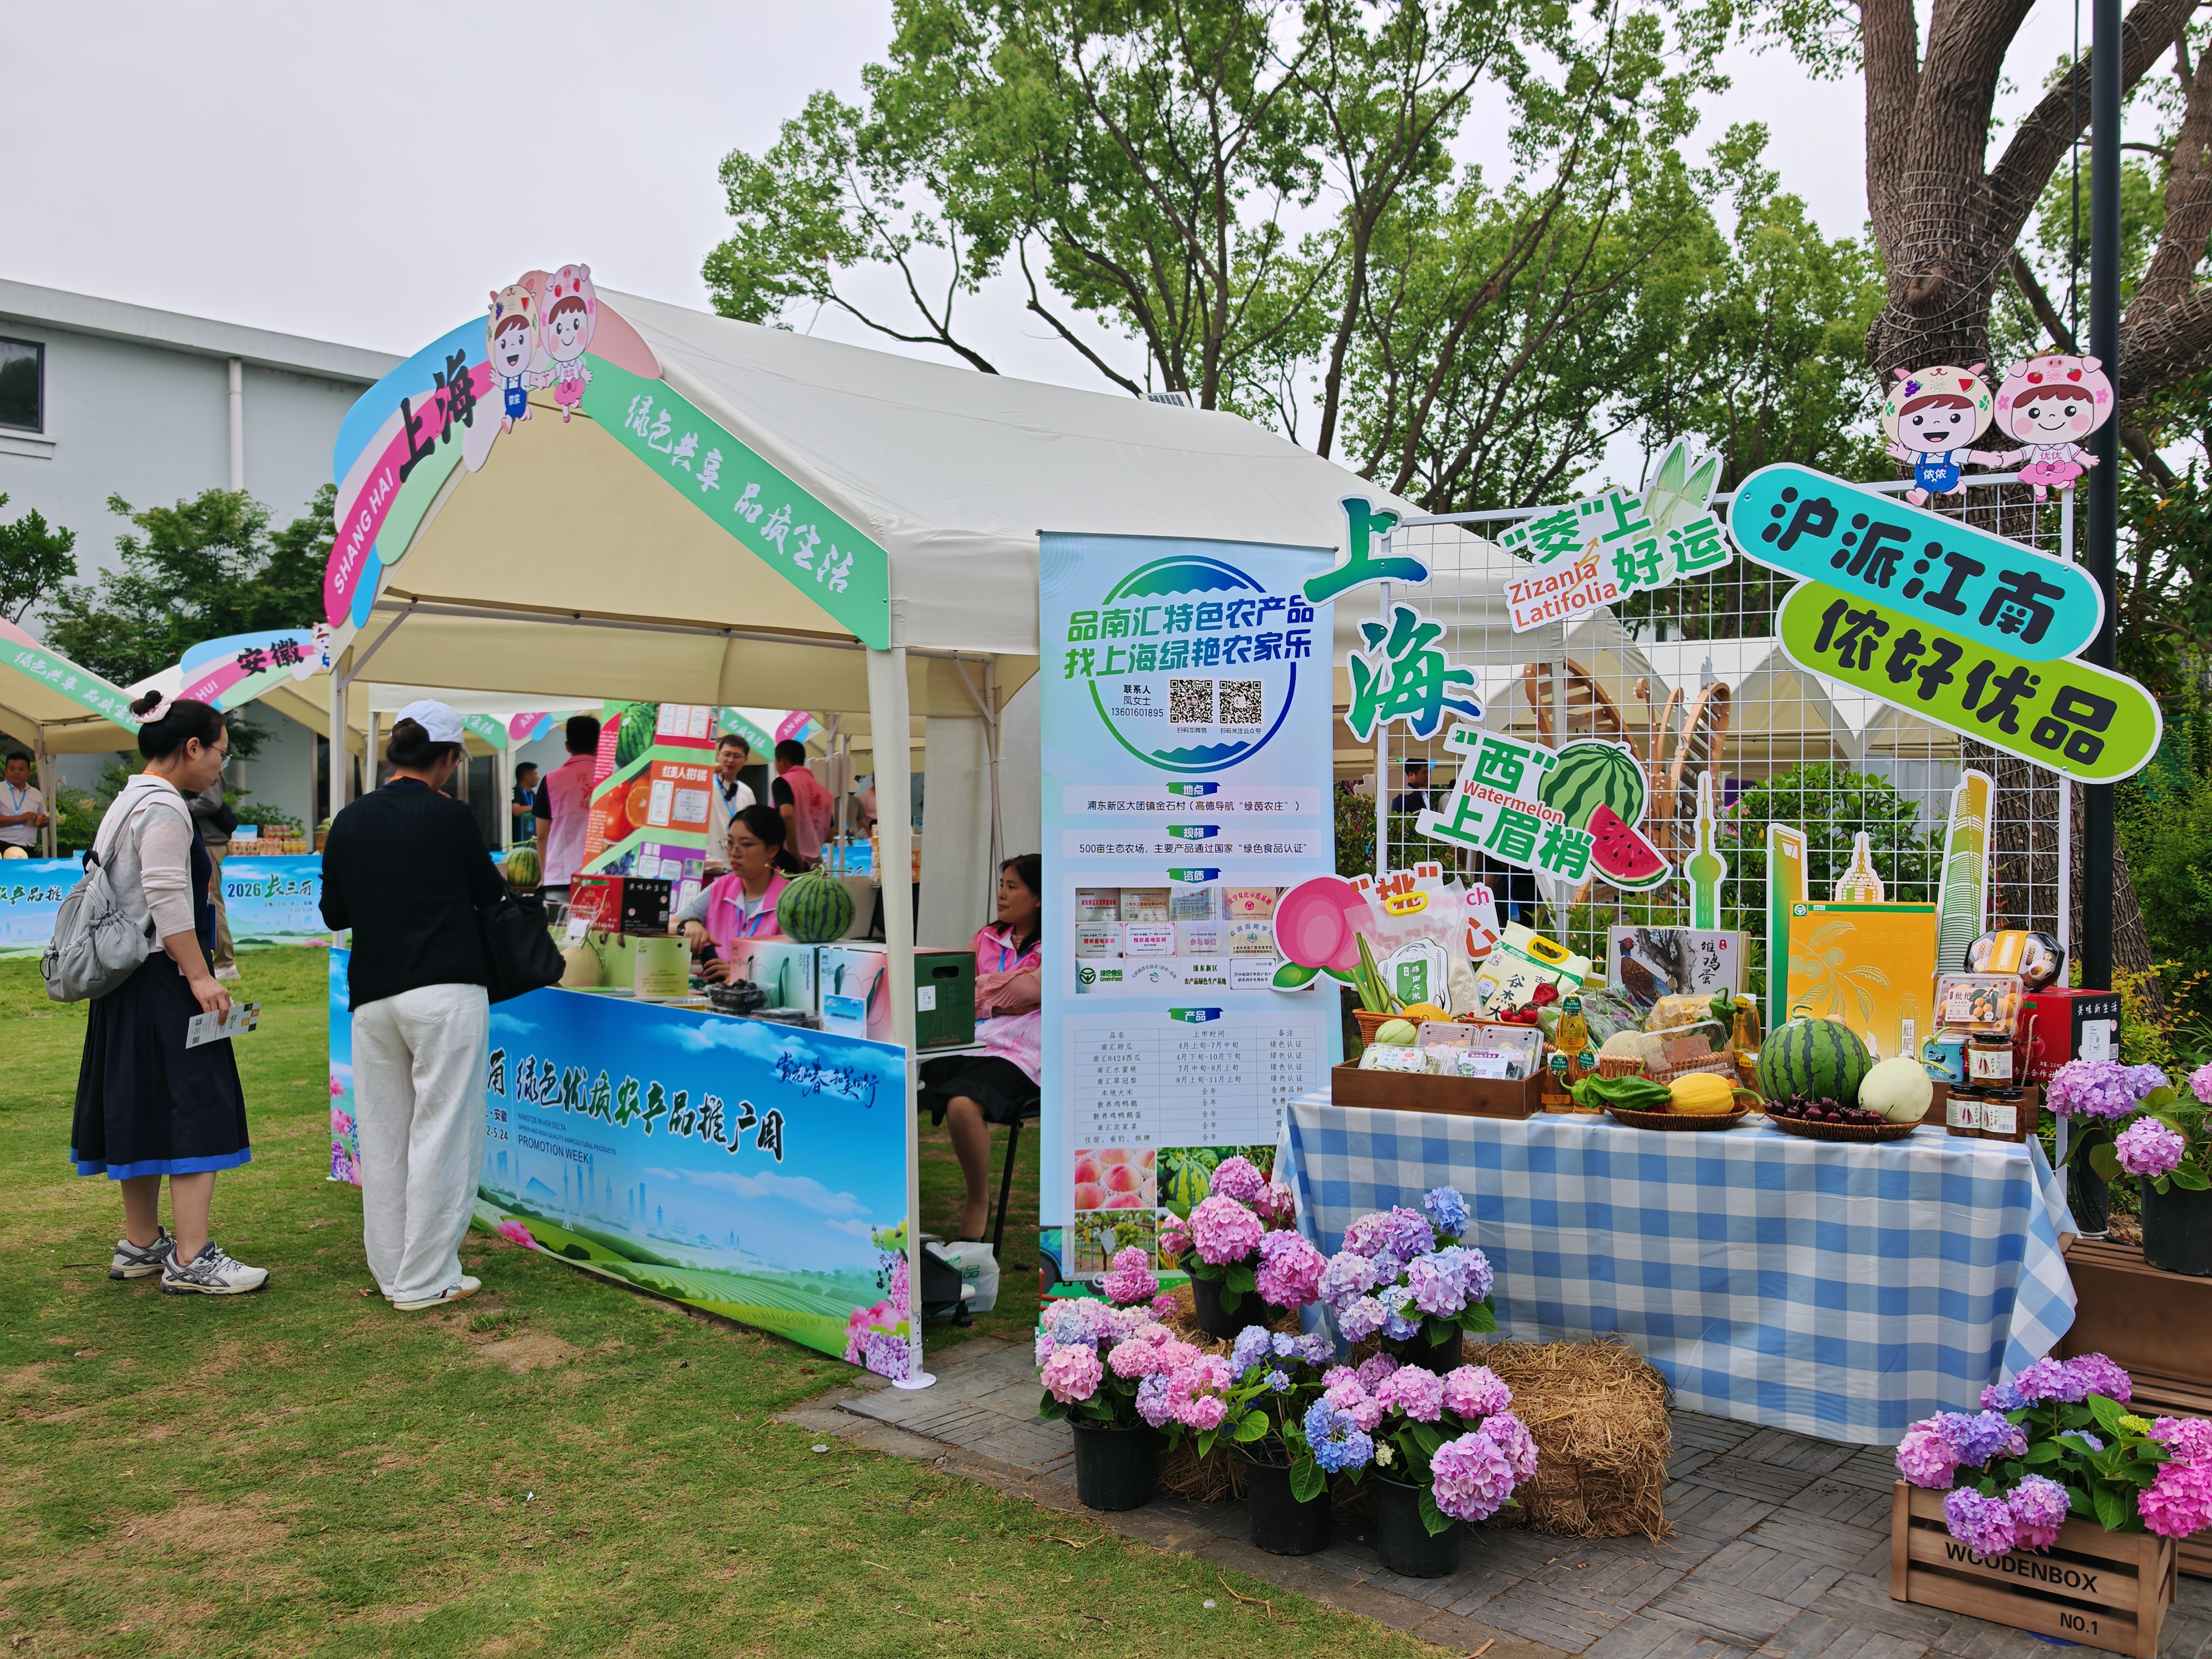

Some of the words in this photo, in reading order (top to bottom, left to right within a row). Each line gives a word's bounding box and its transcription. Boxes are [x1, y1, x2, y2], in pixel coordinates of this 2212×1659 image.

[400, 349, 476, 483] 上海
[2040, 451, 2062, 460] 优优
[1923, 468, 1946, 480] 侬侬
[625, 394, 723, 492] 绿色共享
[734, 482, 853, 593] 品质生活
[334, 510, 373, 594] SHANG
[370, 468, 394, 515] HAI
[1611, 516, 1727, 593] 好运
[1762, 487, 2065, 645] 沪派江南
[1509, 561, 1599, 604] Zizania
[1515, 581, 1618, 629] Latifolia
[1067, 595, 1314, 643] 品南汇特色农产品
[1303, 498, 1481, 736] 上海
[237, 638, 304, 677] 安徽
[1064, 629, 1311, 680] 找上海绿艳农家乐
[1123, 684, 1151, 694] 联系人
[1814, 599, 2117, 766] 侬好优品
[1111, 707, 1164, 717] 13601601895
[662, 766, 707, 782] 红美人柑橘
[1183, 784, 1204, 795] 地点
[1464, 779, 1563, 824] Watermelon
[1183, 827, 1205, 839] 规模
[1432, 795, 1594, 880] 上眉梢
[1183, 871, 1205, 881] 资质
[227, 883, 261, 898] 2026
[264, 874, 312, 899] 长三角
[1190, 938, 1217, 946] 参与单位
[1955, 992, 1972, 1000] 枇杷
[1185, 1011, 1206, 1022] 产品
[2078, 1001, 2117, 1016] 美味新生活
[1903, 1023, 1913, 1051] 枇杷
[1102, 1043, 1132, 1051] 南汇甜瓜
[1178, 1042, 1238, 1050] 4月上旬-7月中旬
[1093, 1054, 1141, 1063] 南汇8424西瓜
[1176, 1053, 1241, 1061] 4月下旬-10月下旬
[1097, 1065, 1137, 1074] 南汇水蜜桃
[1178, 1064, 1239, 1073] 7月中旬-8月上旬
[1176, 1075, 1242, 1084] 8月上旬-11月上旬
[1271, 1074, 1303, 1082] 绿色认证
[1102, 1089, 1133, 1097] 本地大米
[1202, 1087, 1217, 1095] 全年
[516, 1055, 784, 1162] 绿色优质农产品推广周
[518, 1112, 537, 1124] YANGTZE
[538, 1118, 552, 1127] RIVER
[552, 1121, 567, 1131] DELTA
[518, 1124, 530, 1132] GREEN
[594, 1143, 616, 1155] PRODUCTS
[518, 1134, 564, 1158] PROMOTION
[565, 1148, 590, 1164] WEEK
[1945, 1542, 2098, 1594] WOODENBOX
[2060, 1612, 2098, 1635] NO.1
